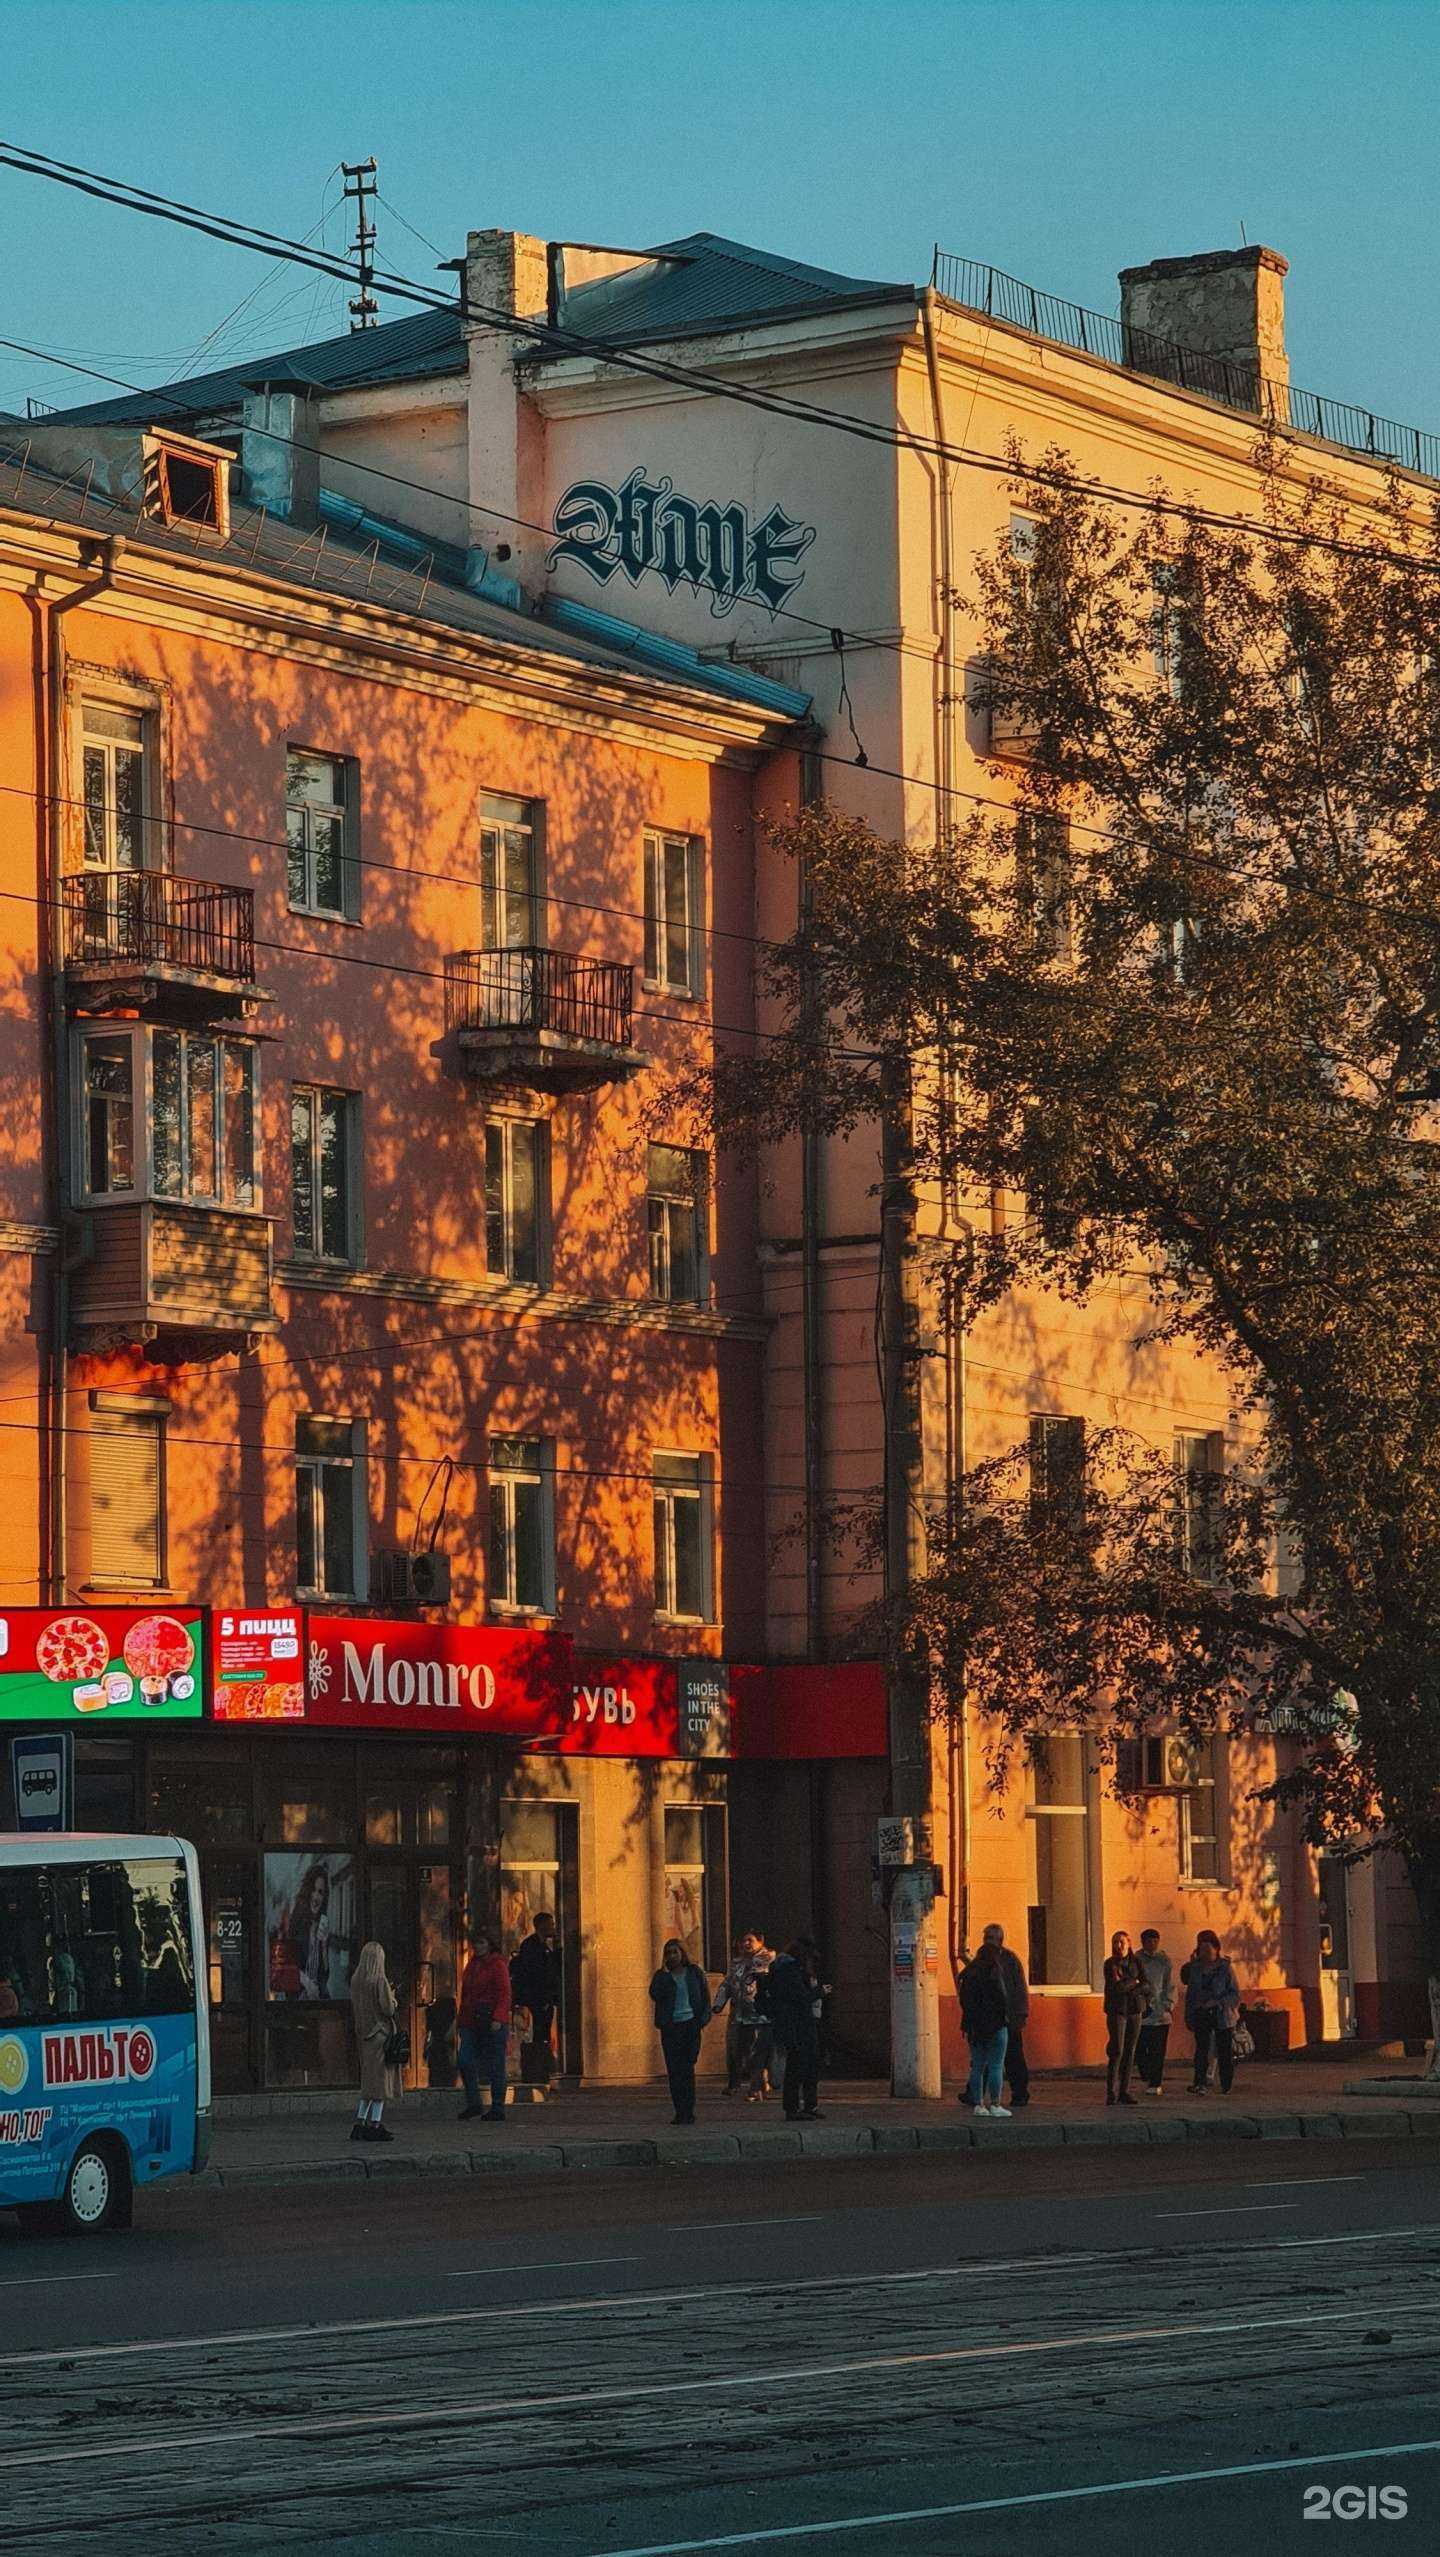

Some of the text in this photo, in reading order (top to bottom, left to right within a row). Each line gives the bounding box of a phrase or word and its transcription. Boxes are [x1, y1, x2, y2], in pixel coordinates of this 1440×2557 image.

[221, 1616, 297, 1636] 5 пицц
[340, 1640, 496, 1710] Monro
[687, 1682, 720, 1697] SHOES
[687, 1700, 721, 1715] IN THE
[687, 1718, 712, 1733] CITY
[217, 1920, 243, 1937] 8-22
[44, 2030, 154, 2085] ПАЛЬТО
